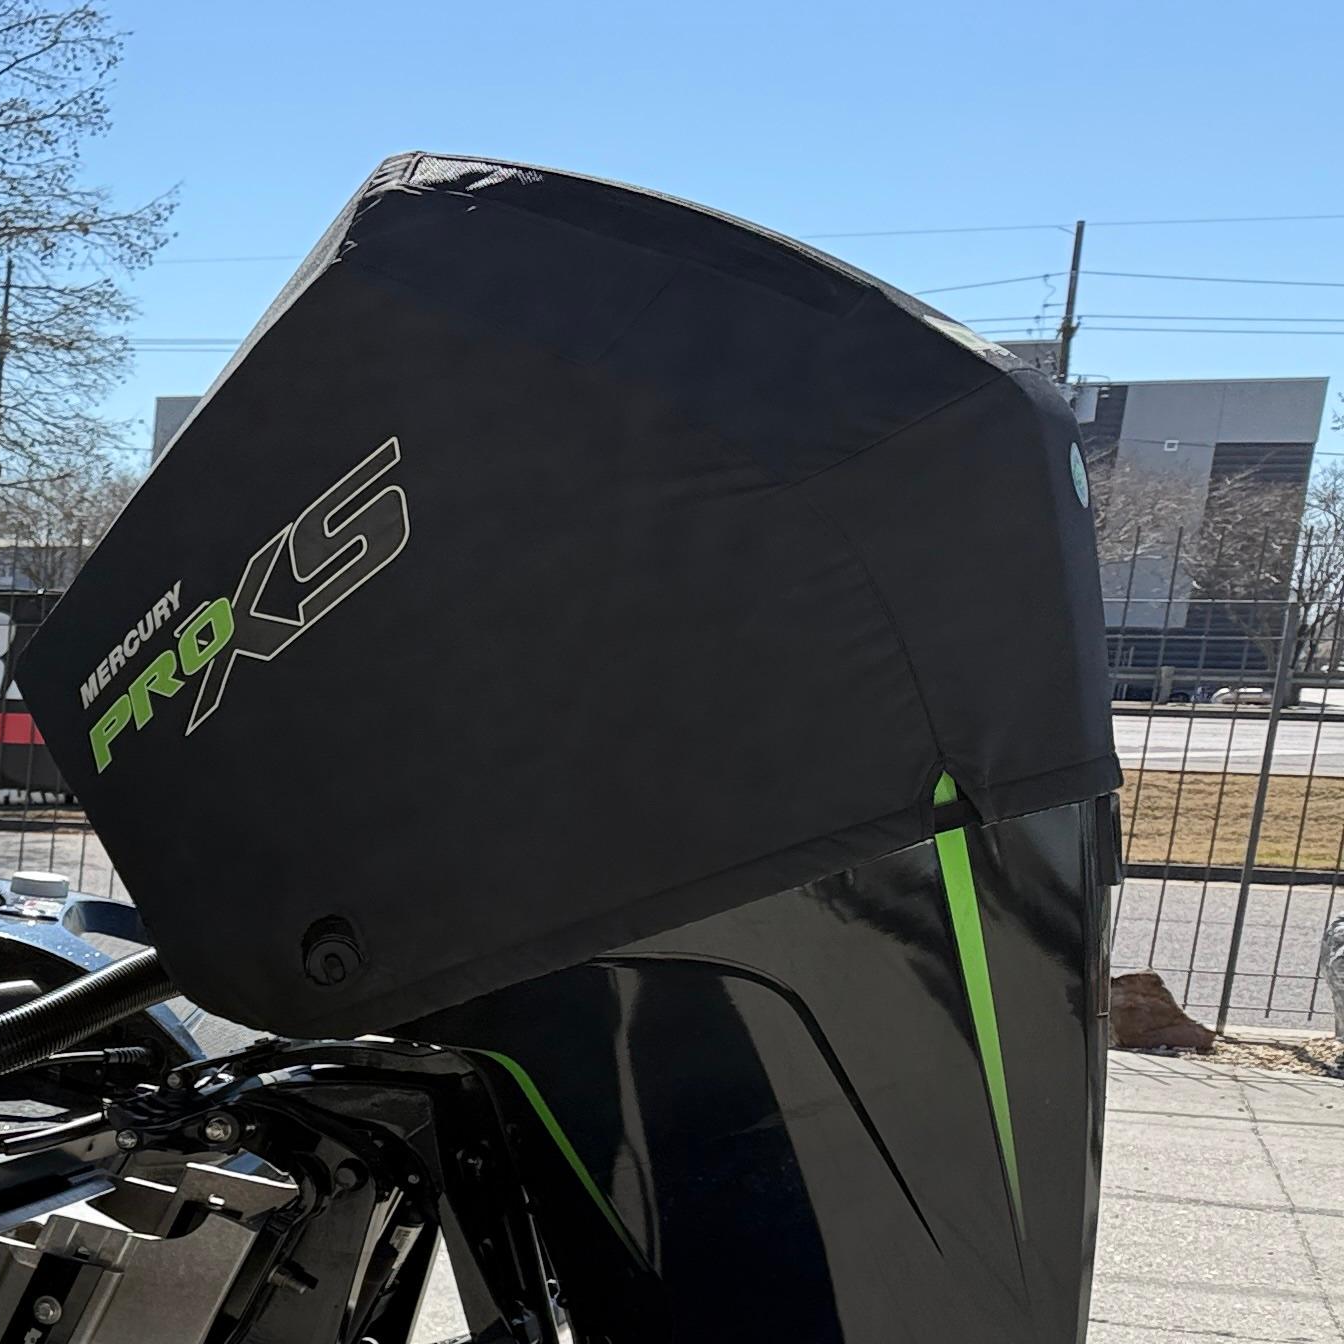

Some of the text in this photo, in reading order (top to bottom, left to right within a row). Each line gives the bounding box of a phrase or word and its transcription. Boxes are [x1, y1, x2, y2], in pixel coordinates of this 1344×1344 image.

[80, 580, 182, 709] MERCURY
[89, 436, 411, 774] PRO XS
